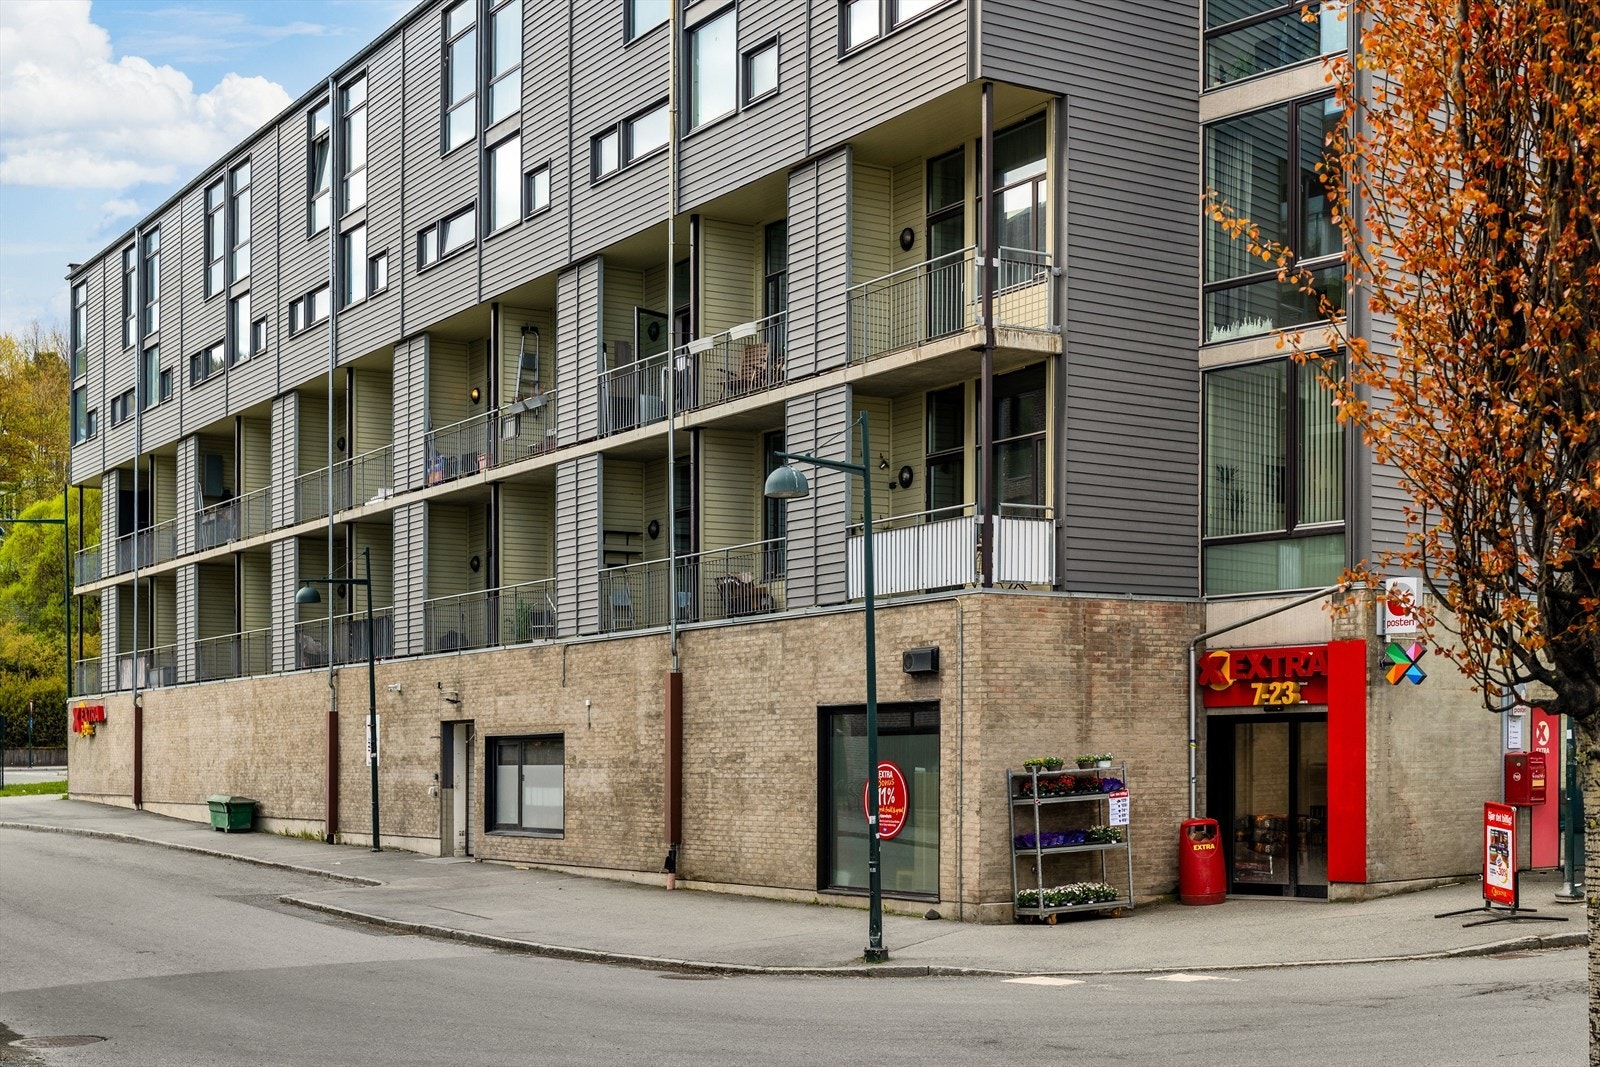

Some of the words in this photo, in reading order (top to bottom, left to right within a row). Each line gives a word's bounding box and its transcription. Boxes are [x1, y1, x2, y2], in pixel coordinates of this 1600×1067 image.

[1387, 618, 1414, 628] posten
[1230, 652, 1328, 679] EXTRA
[1251, 681, 1297, 705] 7-23
